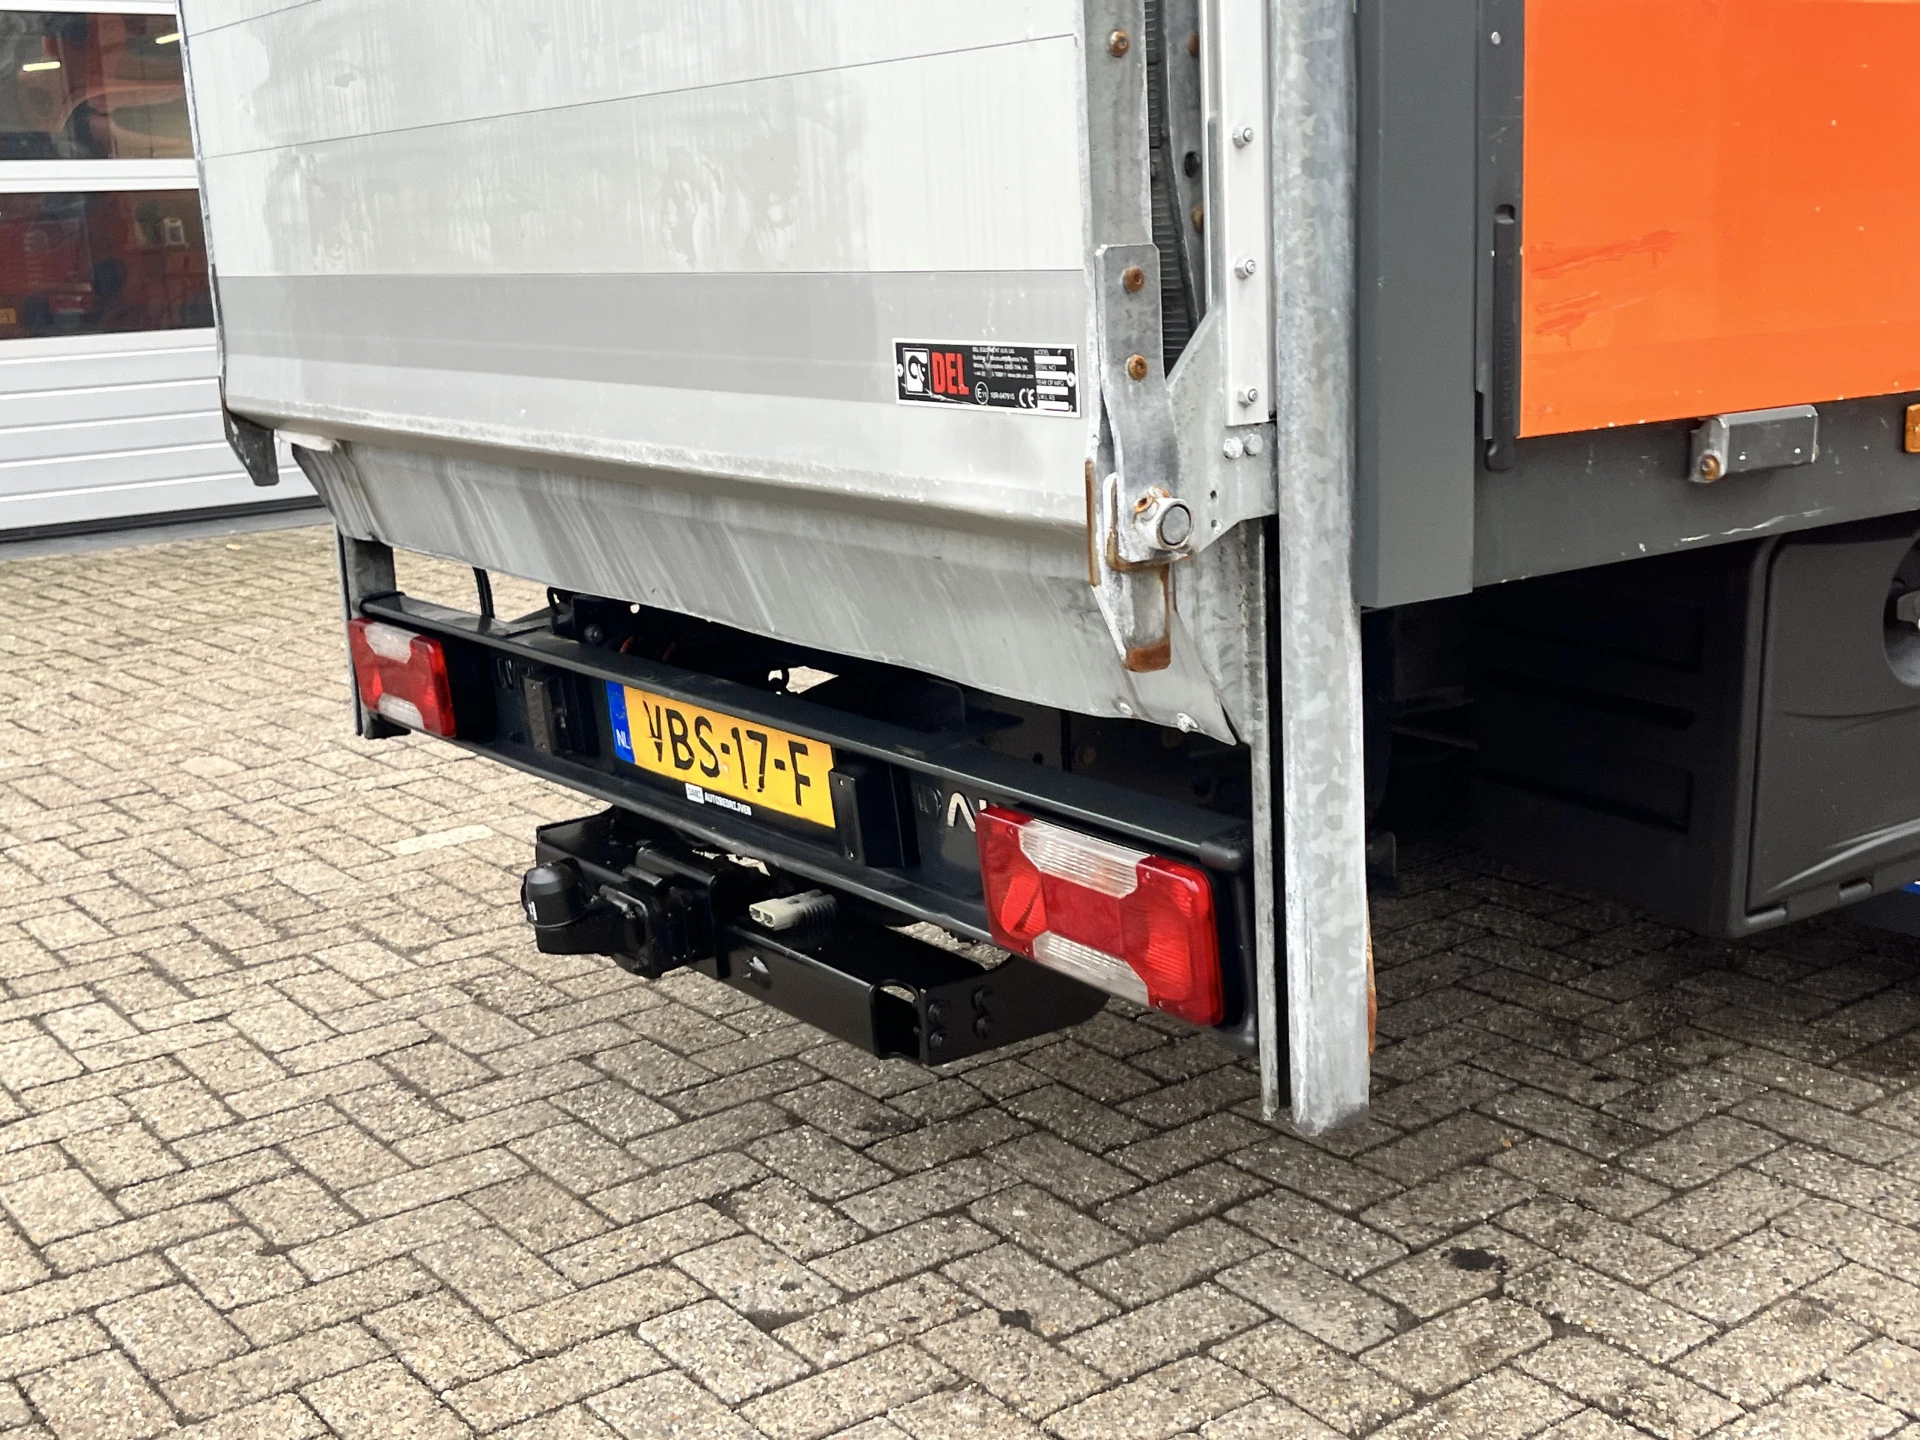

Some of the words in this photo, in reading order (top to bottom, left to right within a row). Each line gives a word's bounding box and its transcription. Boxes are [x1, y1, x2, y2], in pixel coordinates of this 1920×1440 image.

[931, 351, 970, 395] DEL
[616, 726, 631, 750] NL
[642, 699, 811, 807] VBS-17-F
